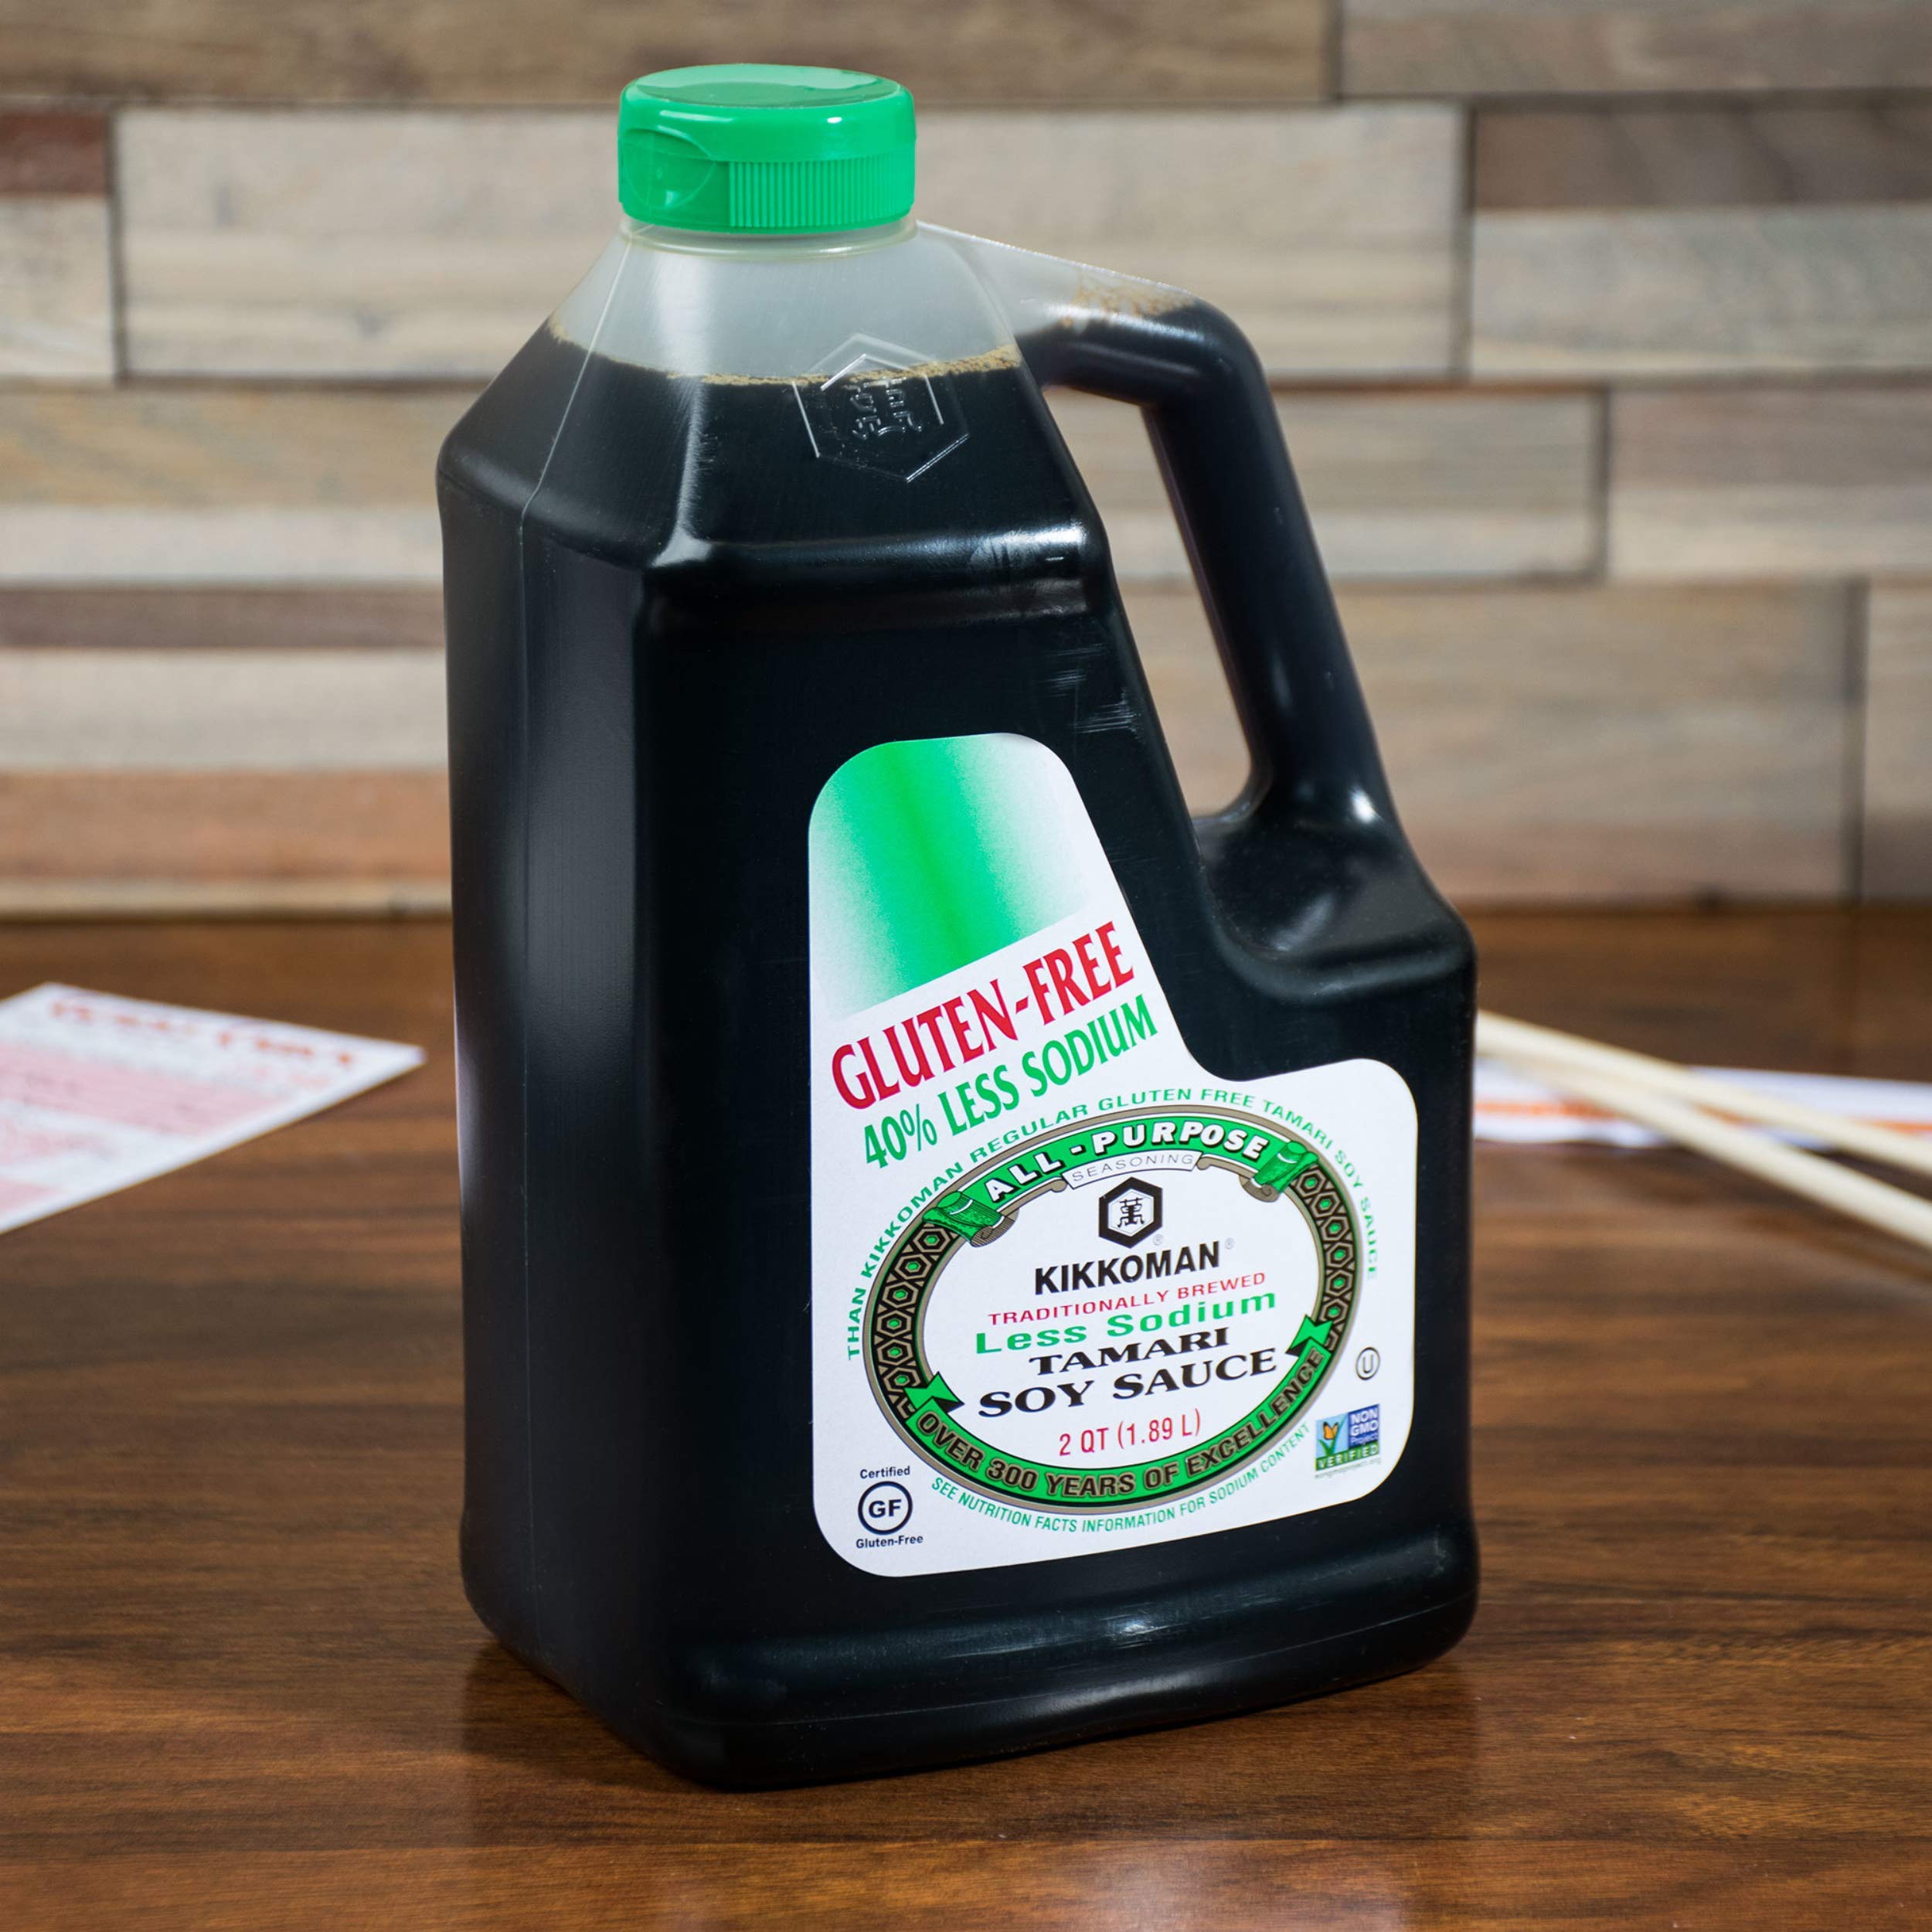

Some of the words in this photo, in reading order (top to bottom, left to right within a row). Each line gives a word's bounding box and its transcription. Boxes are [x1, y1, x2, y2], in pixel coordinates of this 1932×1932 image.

[832, 920, 1134, 1110] GLUTEN-FREE
[863, 1104, 969, 1168] 40%
[937, 1064, 1019, 1136] LESS
[1021, 994, 1158, 1097] SODIUM
[1072, 1154, 1194, 1182] SEASONING
[848, 1287, 866, 1360] THAN
[860, 1162, 964, 1278] KIKKOMAN
[969, 1104, 1088, 1164] REGULAR
[1098, 1088, 1192, 1111] GLUTEN
[1200, 1088, 1255, 1108] FREE
[1263, 1099, 1334, 1150] TAMARI
[1335, 1149, 1363, 1189] SOY
[1359, 1196, 1378, 1280] SAUCE
[1035, 1240, 1220, 1295] KIKKOMAN
[975, 1325, 1087, 1354] Less
[1106, 1292, 1276, 1338] Sodium
[988, 1290, 1169, 1326] TRADITIONALLY
[1177, 1272, 1266, 1299] BREWED
[1029, 1326, 1230, 1376] TAMARI
[978, 1380, 1095, 1418] SOY
[1112, 1347, 1277, 1400] SAUCE
[917, 1410, 985, 1471] OVER
[986, 1458, 1039, 1492] 300
[1046, 1471, 1136, 1498] YEARS
[1144, 1461, 1179, 1489] OF
[1186, 1347, 1325, 1478] EXCELLENCE
[1059, 1433, 1071, 1456] 2
[1080, 1427, 1109, 1454] QT
[1117, 1417, 1173, 1450] (1.89
[1182, 1408, 1201, 1437] L)
[1351, 1407, 1379, 1425] NON
[1351, 1420, 1379, 1437] GMO
[859, 1465, 911, 1479] Certified
[931, 1476, 959, 1500] SEE
[957, 1491, 1032, 1527] NUTRITION
[1034, 1515, 1077, 1532] FACTS
[1081, 1506, 1176, 1532] INFORMATION
[1179, 1496, 1206, 1516] FOR
[1208, 1468, 1259, 1504] SODIUM
[1260, 1422, 1310, 1473] CONTENT
[1318, 1444, 1379, 1470] VERIFIED
[868, 1498, 902, 1519] GF
[855, 1535, 923, 1549] Gluten-Free
